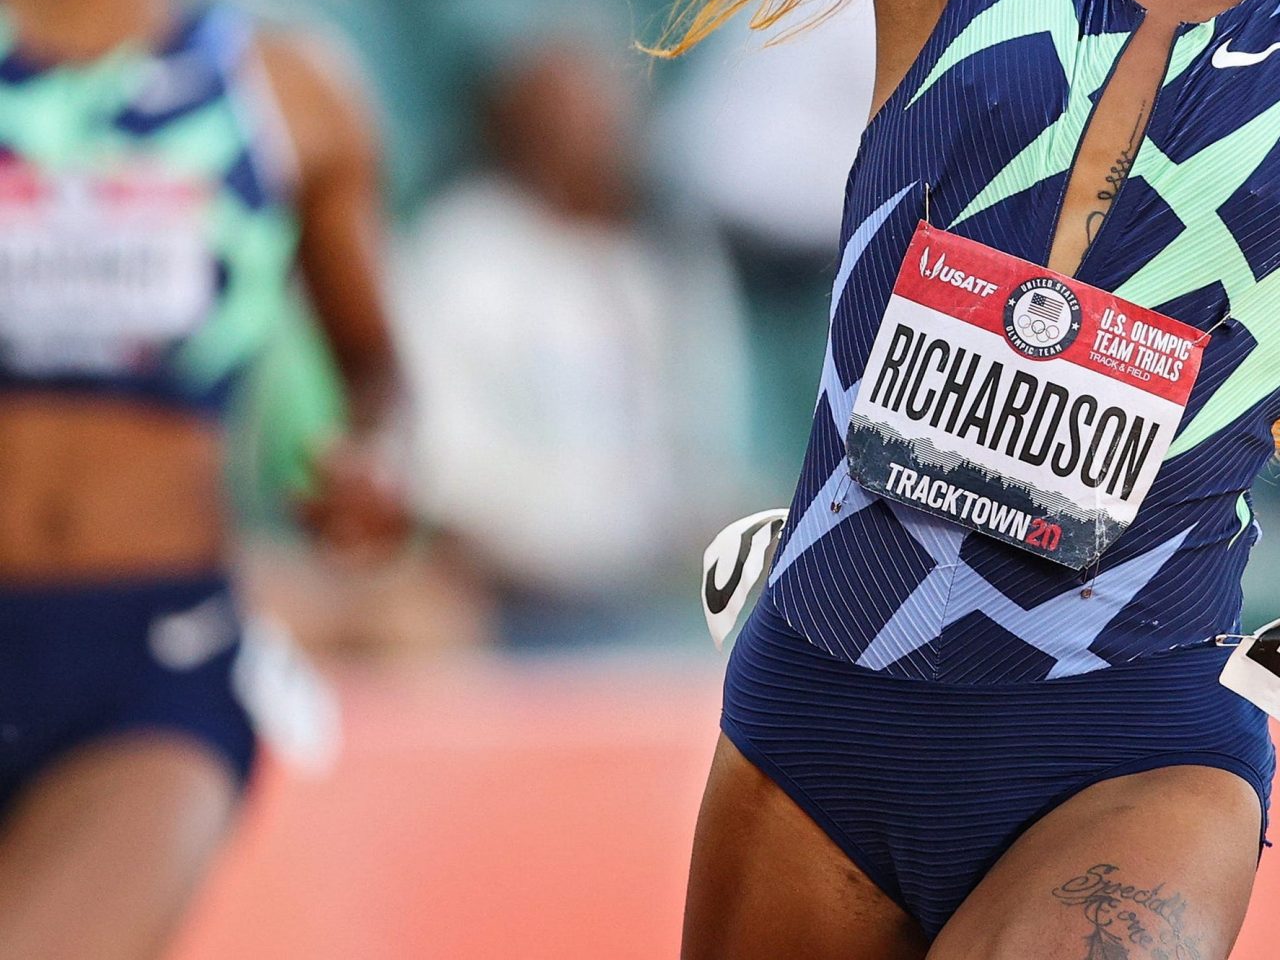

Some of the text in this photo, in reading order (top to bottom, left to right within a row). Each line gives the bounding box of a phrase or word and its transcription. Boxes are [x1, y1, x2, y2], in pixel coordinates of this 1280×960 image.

[939, 265, 999, 298] USATF
[1020, 278, 1080, 311] UNITED STATES
[1005, 325, 1063, 357] OLYMPIC TEAM
[1100, 308, 1193, 362] U.S. OLYMPIC
[1088, 350, 1151, 382] TRACK & FIELD
[1093, 329, 1184, 382] TEAM TRIALS
[868, 323, 1161, 502] RICHARDSON
